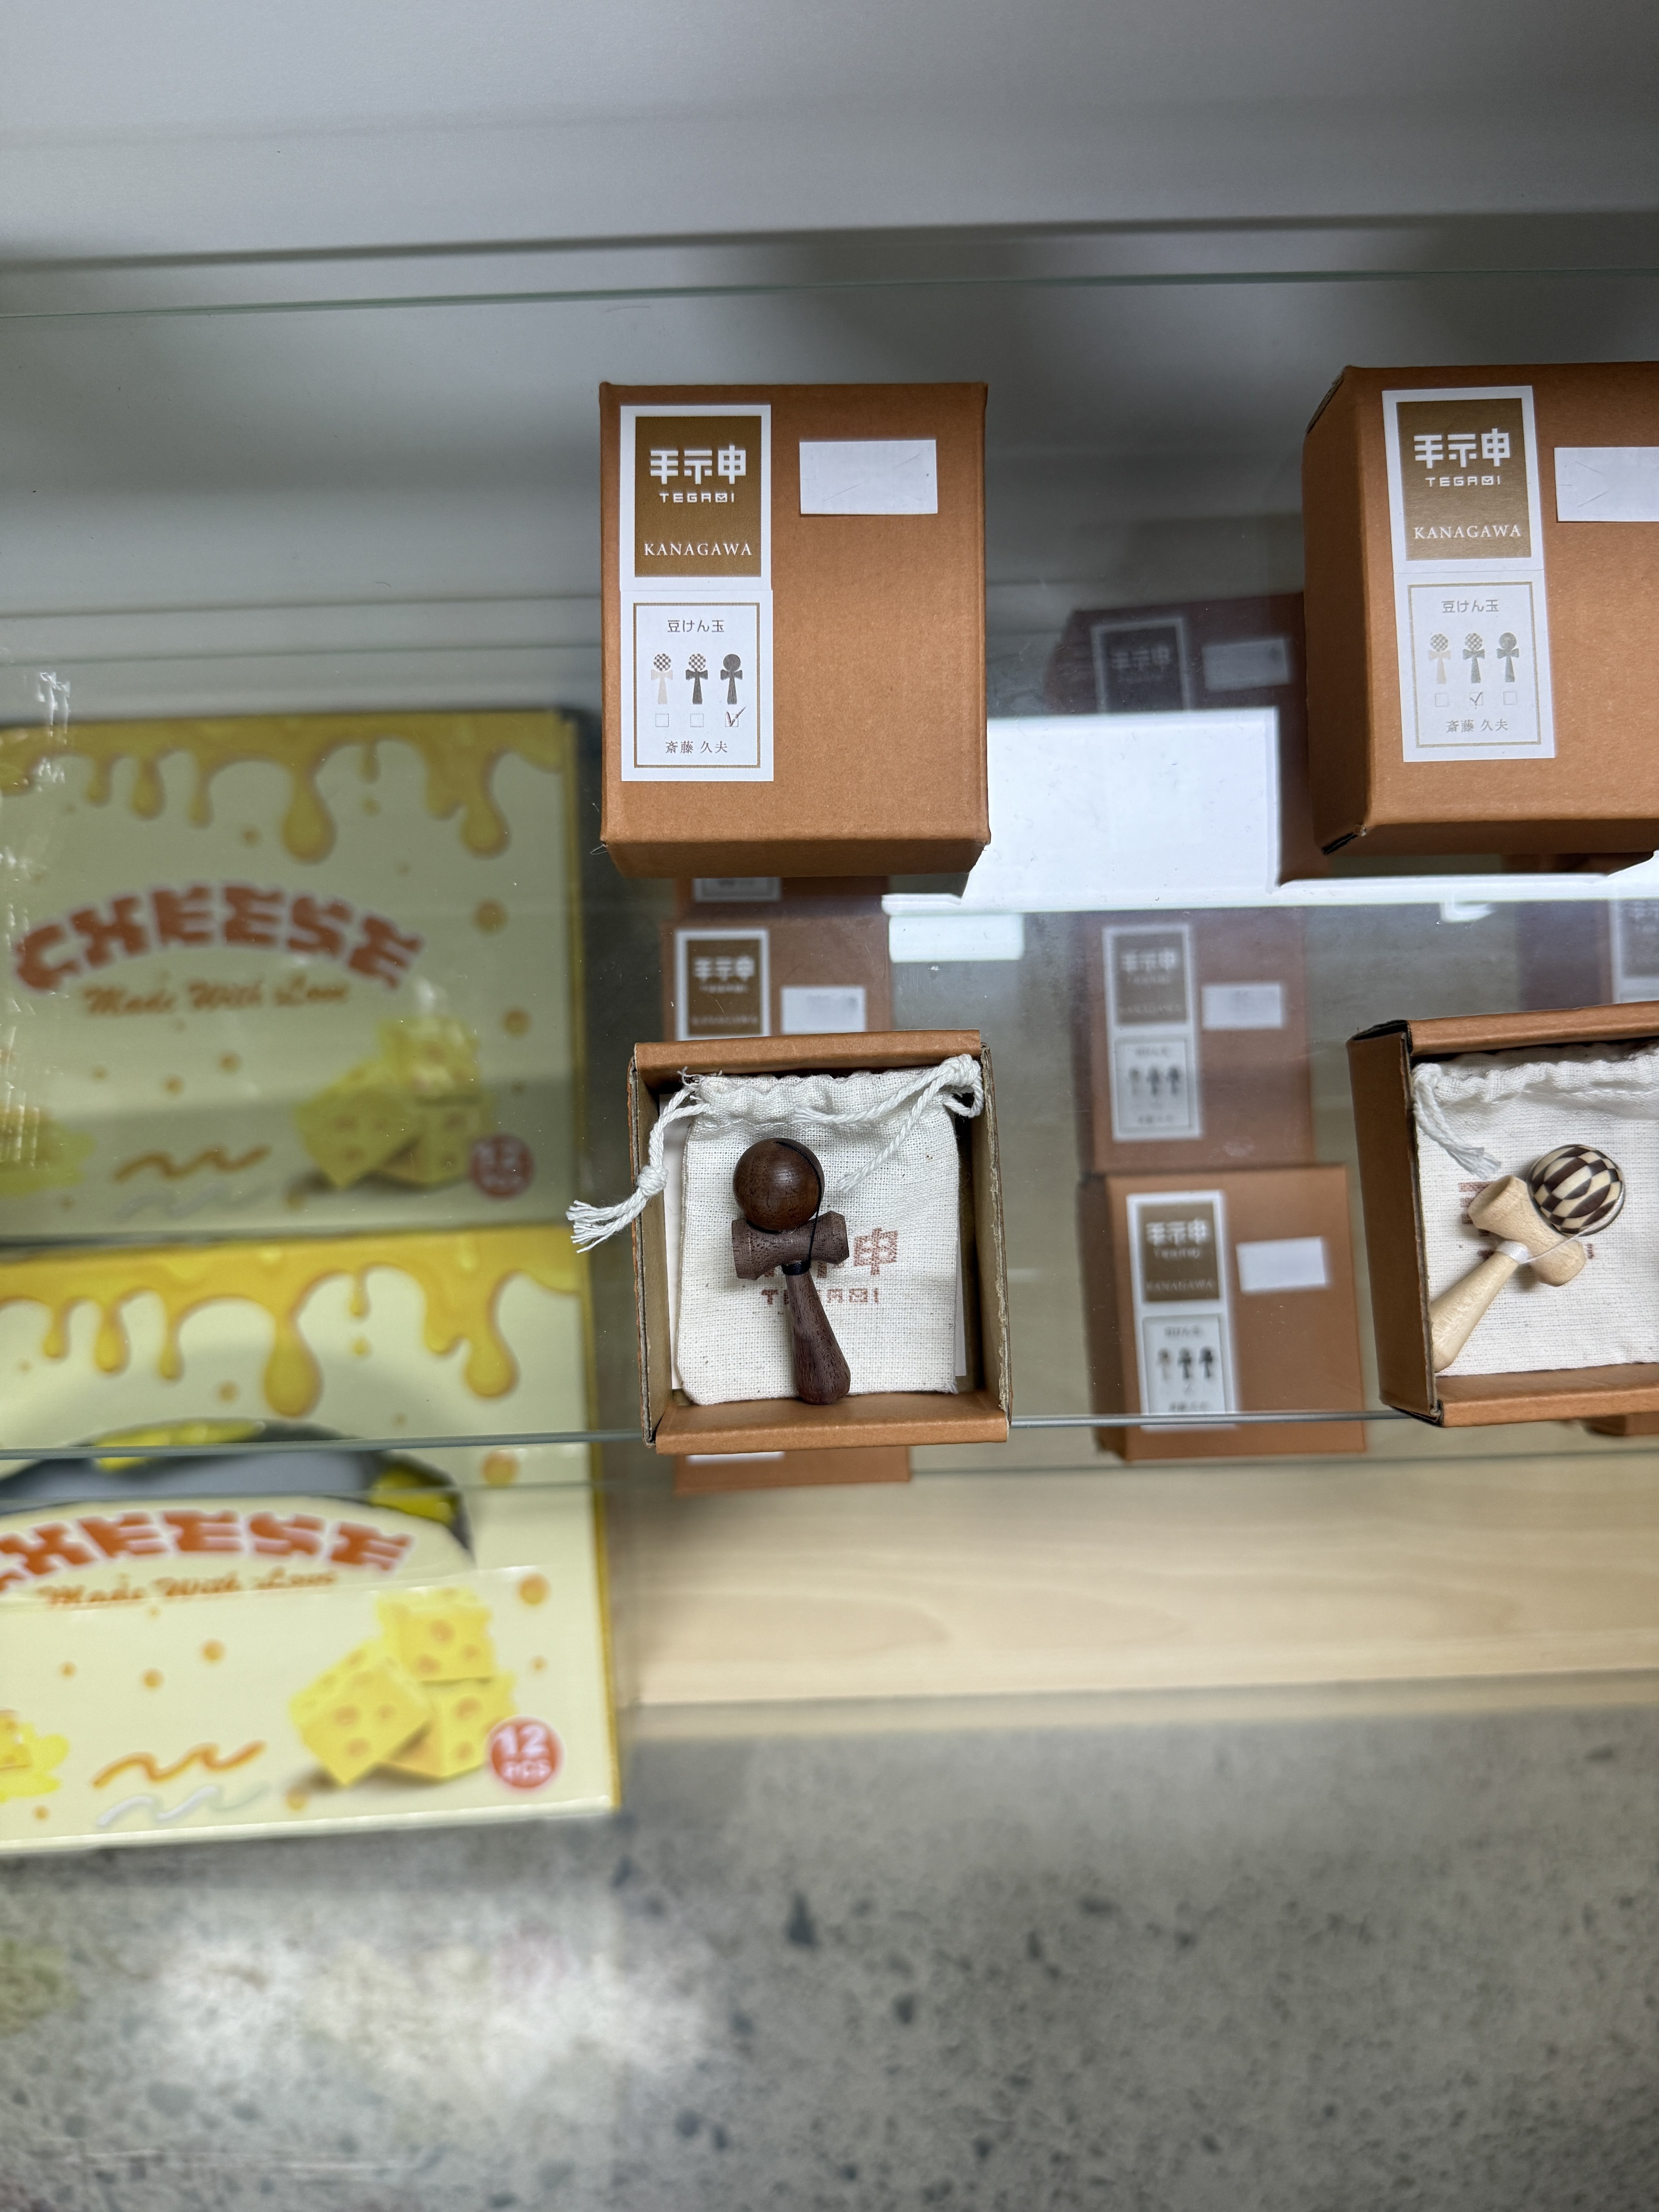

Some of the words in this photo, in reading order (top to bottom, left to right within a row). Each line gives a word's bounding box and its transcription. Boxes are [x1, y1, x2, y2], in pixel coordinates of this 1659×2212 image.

[1425, 476, 1501, 487] TEGAMI
[659, 493, 734, 503] TEGAMI
[1414, 524, 1521, 539] KANAGAWA
[644, 543, 752, 556] KANAGAWA
[1442, 599, 1499, 613] 豆けん玉
[667, 620, 725, 632] 豆けん玉
[1480, 718, 1509, 732] 久夫
[665, 740, 694, 754] 斎藤
[700, 741, 728, 754] 久夫
[15, 885, 423, 990] CHEESE
[761, 1288, 879, 1305] TAMI
[0, 1509, 413, 1592] HEESE
[495, 1725, 547, 1757] 12
